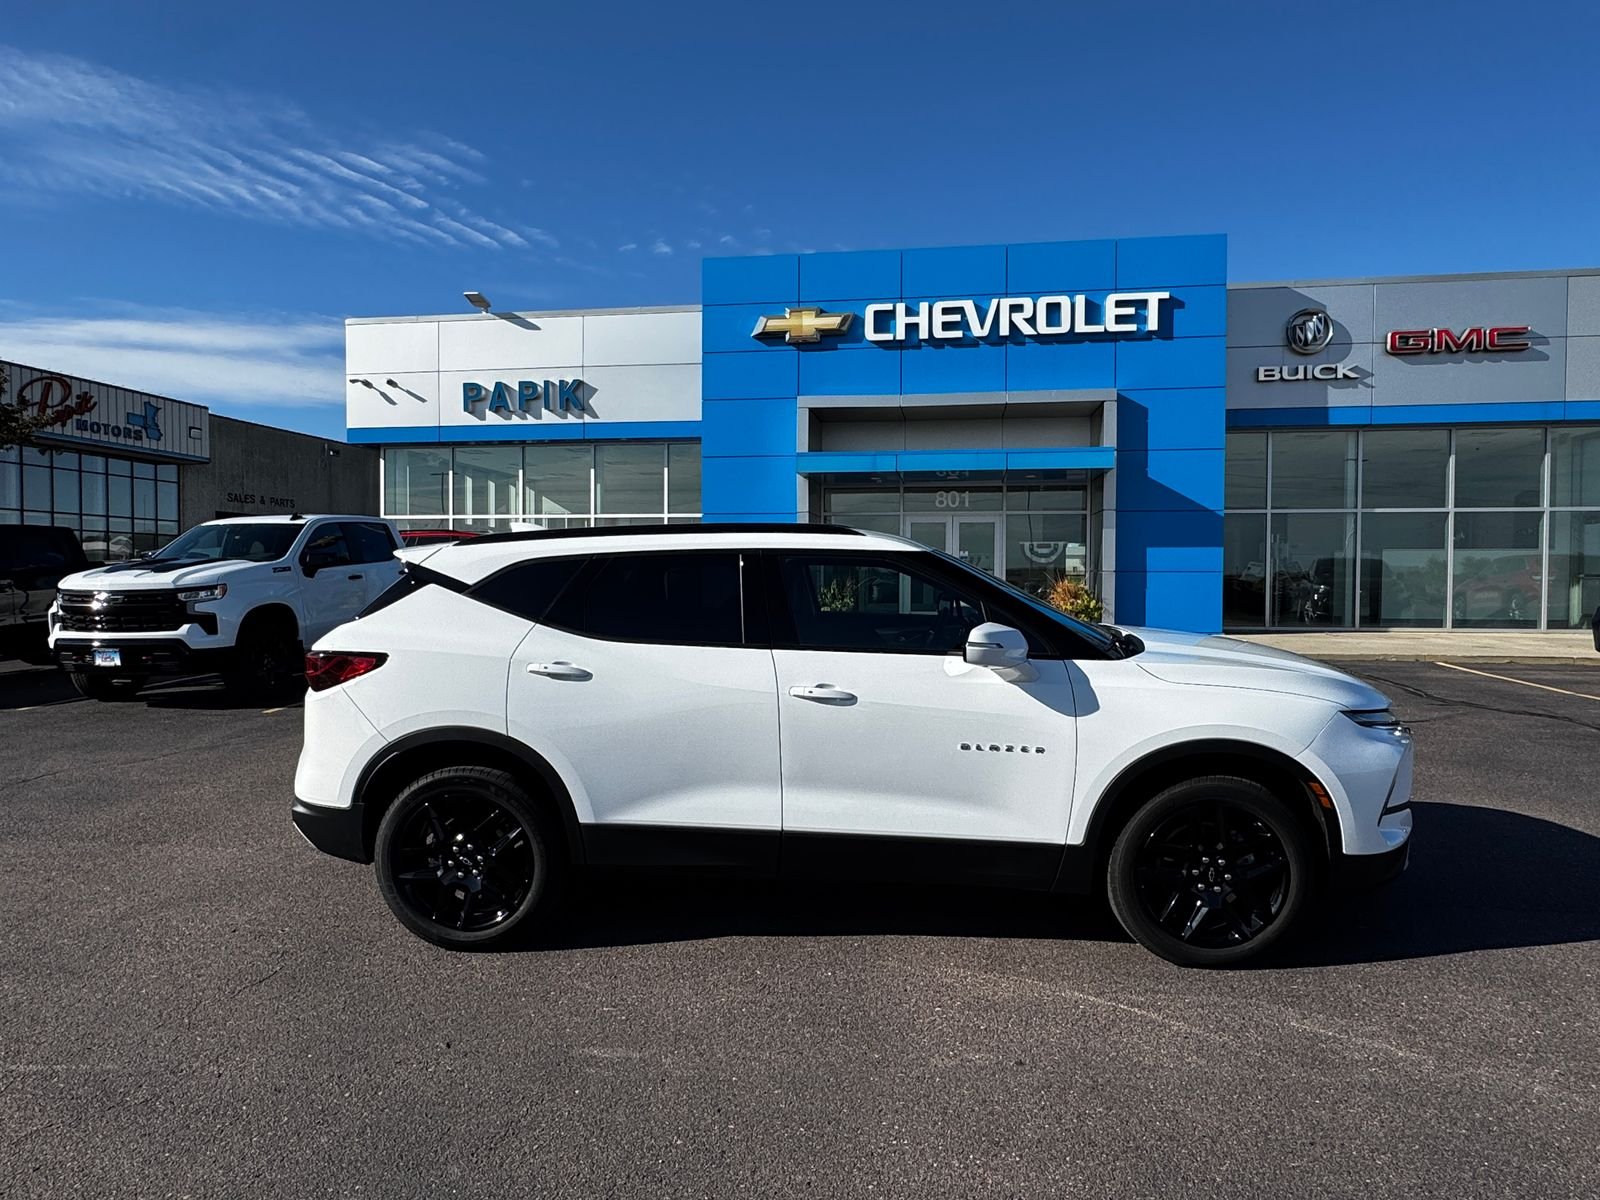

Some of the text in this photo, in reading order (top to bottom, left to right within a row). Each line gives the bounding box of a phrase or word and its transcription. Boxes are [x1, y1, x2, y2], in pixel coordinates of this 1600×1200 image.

[864, 291, 1170, 341] CHEVROLET
[1386, 326, 1532, 354] GMC
[1258, 363, 1361, 382] BUICK
[463, 379, 585, 412] PAPIK
[76, 418, 143, 441] MOTORS
[227, 493, 296, 508] SALES & PARTS
[935, 490, 969, 508] 801
[960, 743, 1046, 754] BLAZER
